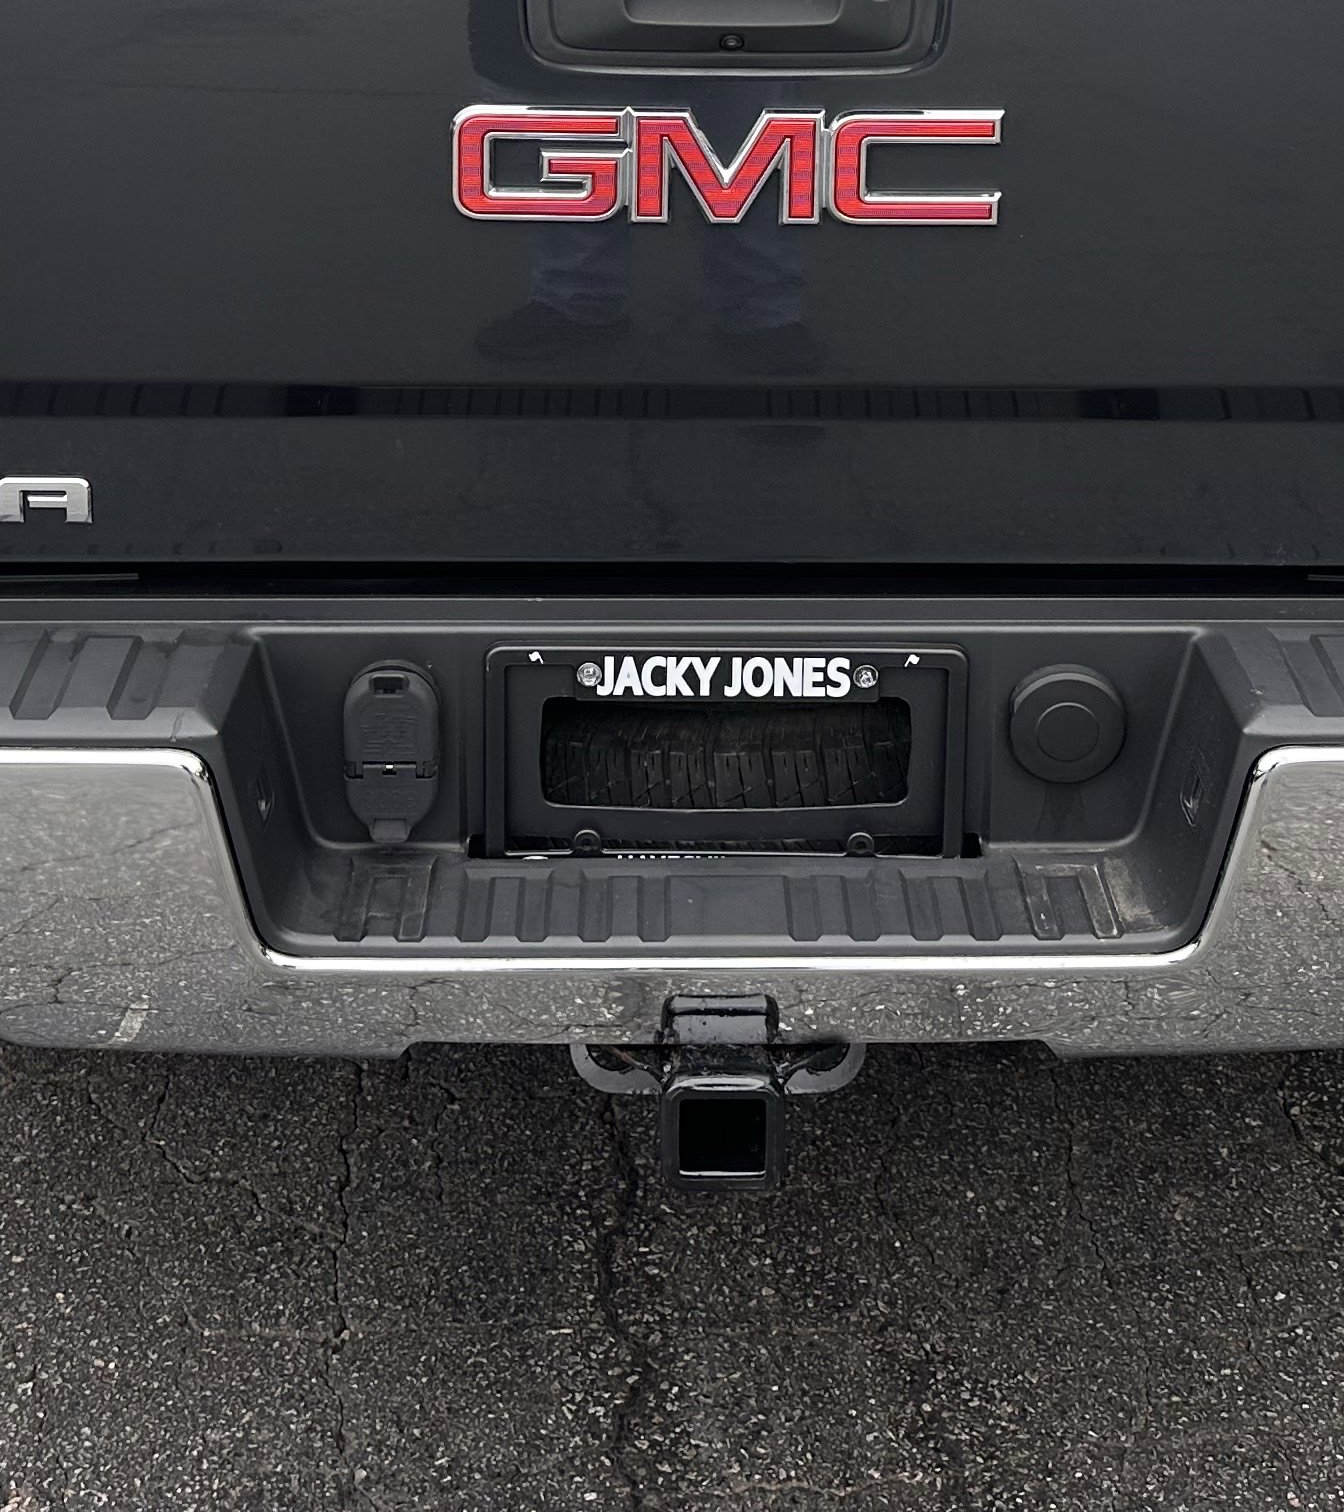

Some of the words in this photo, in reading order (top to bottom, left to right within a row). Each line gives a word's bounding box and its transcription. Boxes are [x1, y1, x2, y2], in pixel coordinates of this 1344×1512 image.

[453, 104, 1005, 225] GMC
[596, 656, 722, 697] JACKY
[723, 657, 851, 698] JONES
